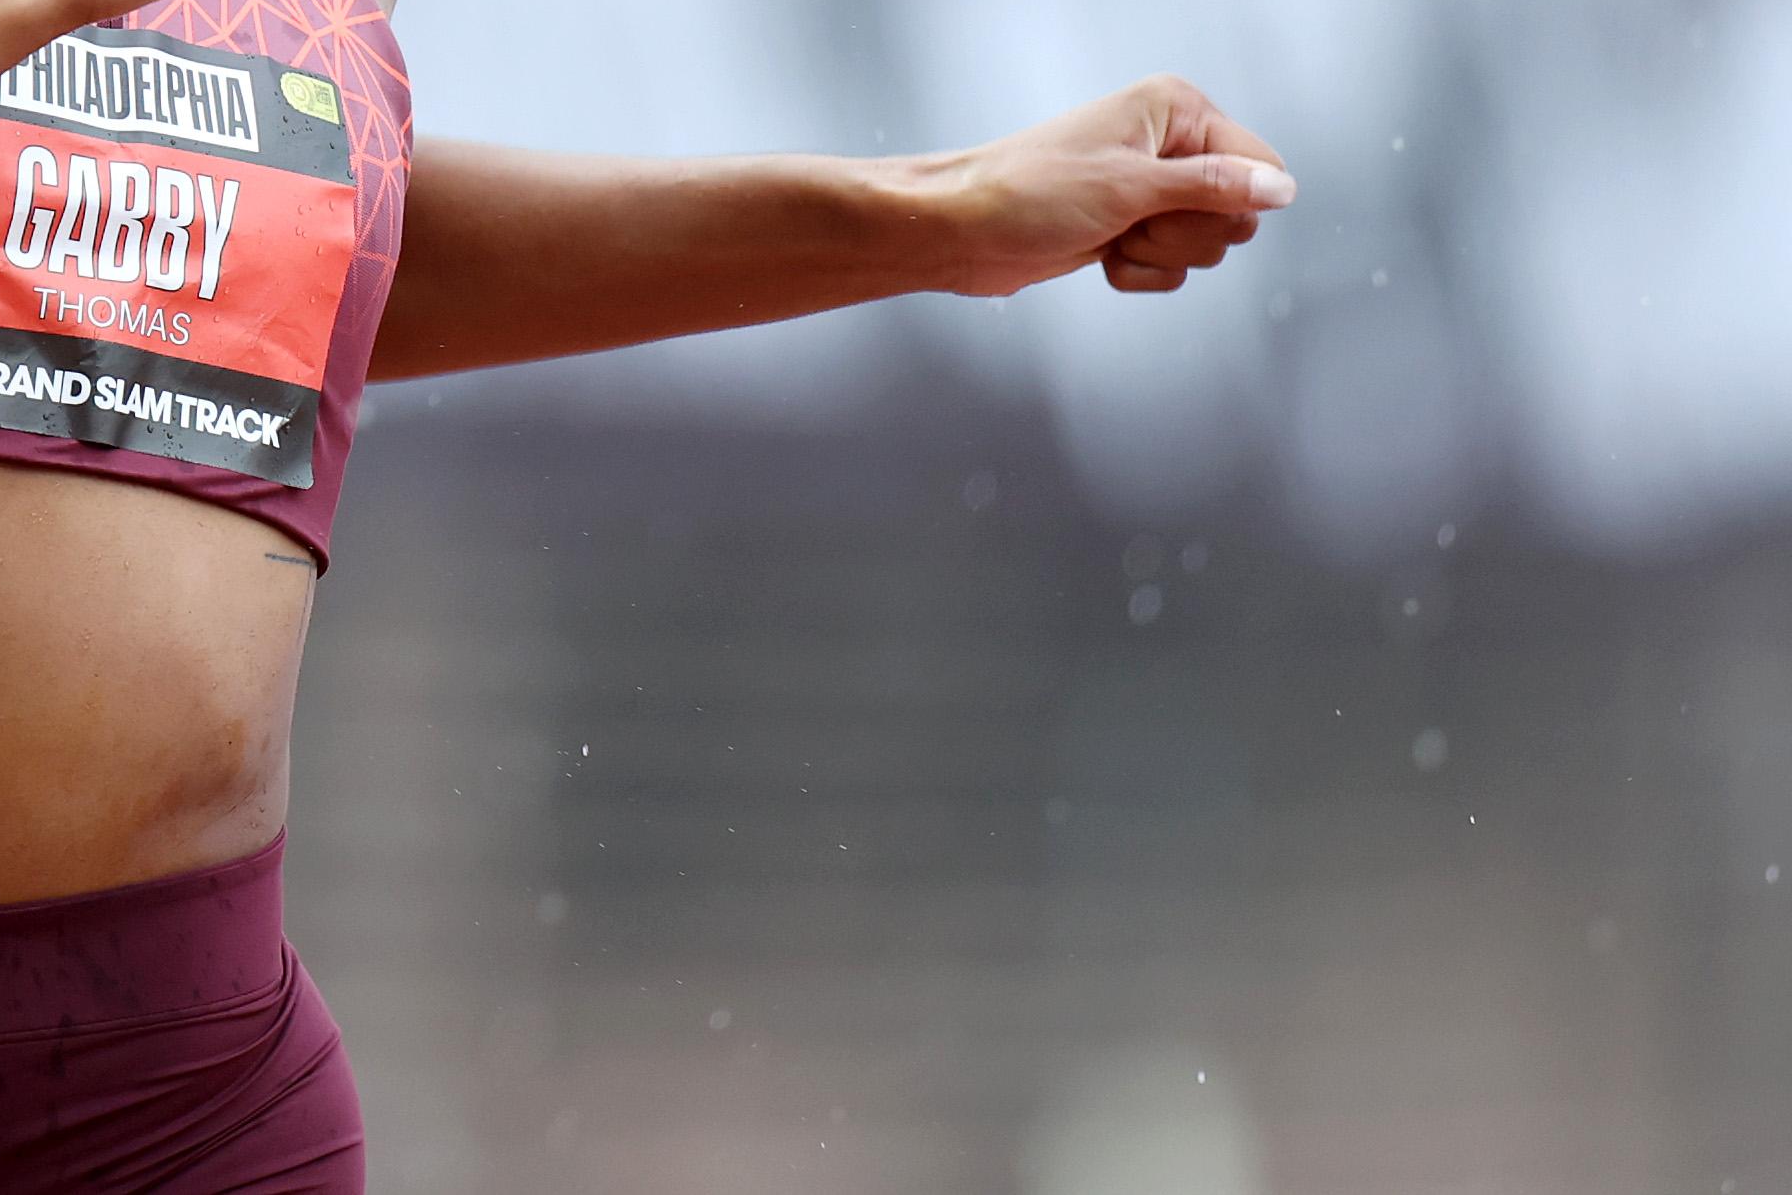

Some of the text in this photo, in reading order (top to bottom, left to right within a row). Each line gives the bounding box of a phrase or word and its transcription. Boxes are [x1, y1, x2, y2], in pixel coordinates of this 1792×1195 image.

[4, 145, 241, 301] GABBY
[33, 286, 192, 345] THOMAS
[94, 375, 174, 425] SLAM
[175, 393, 290, 449] TRACK
